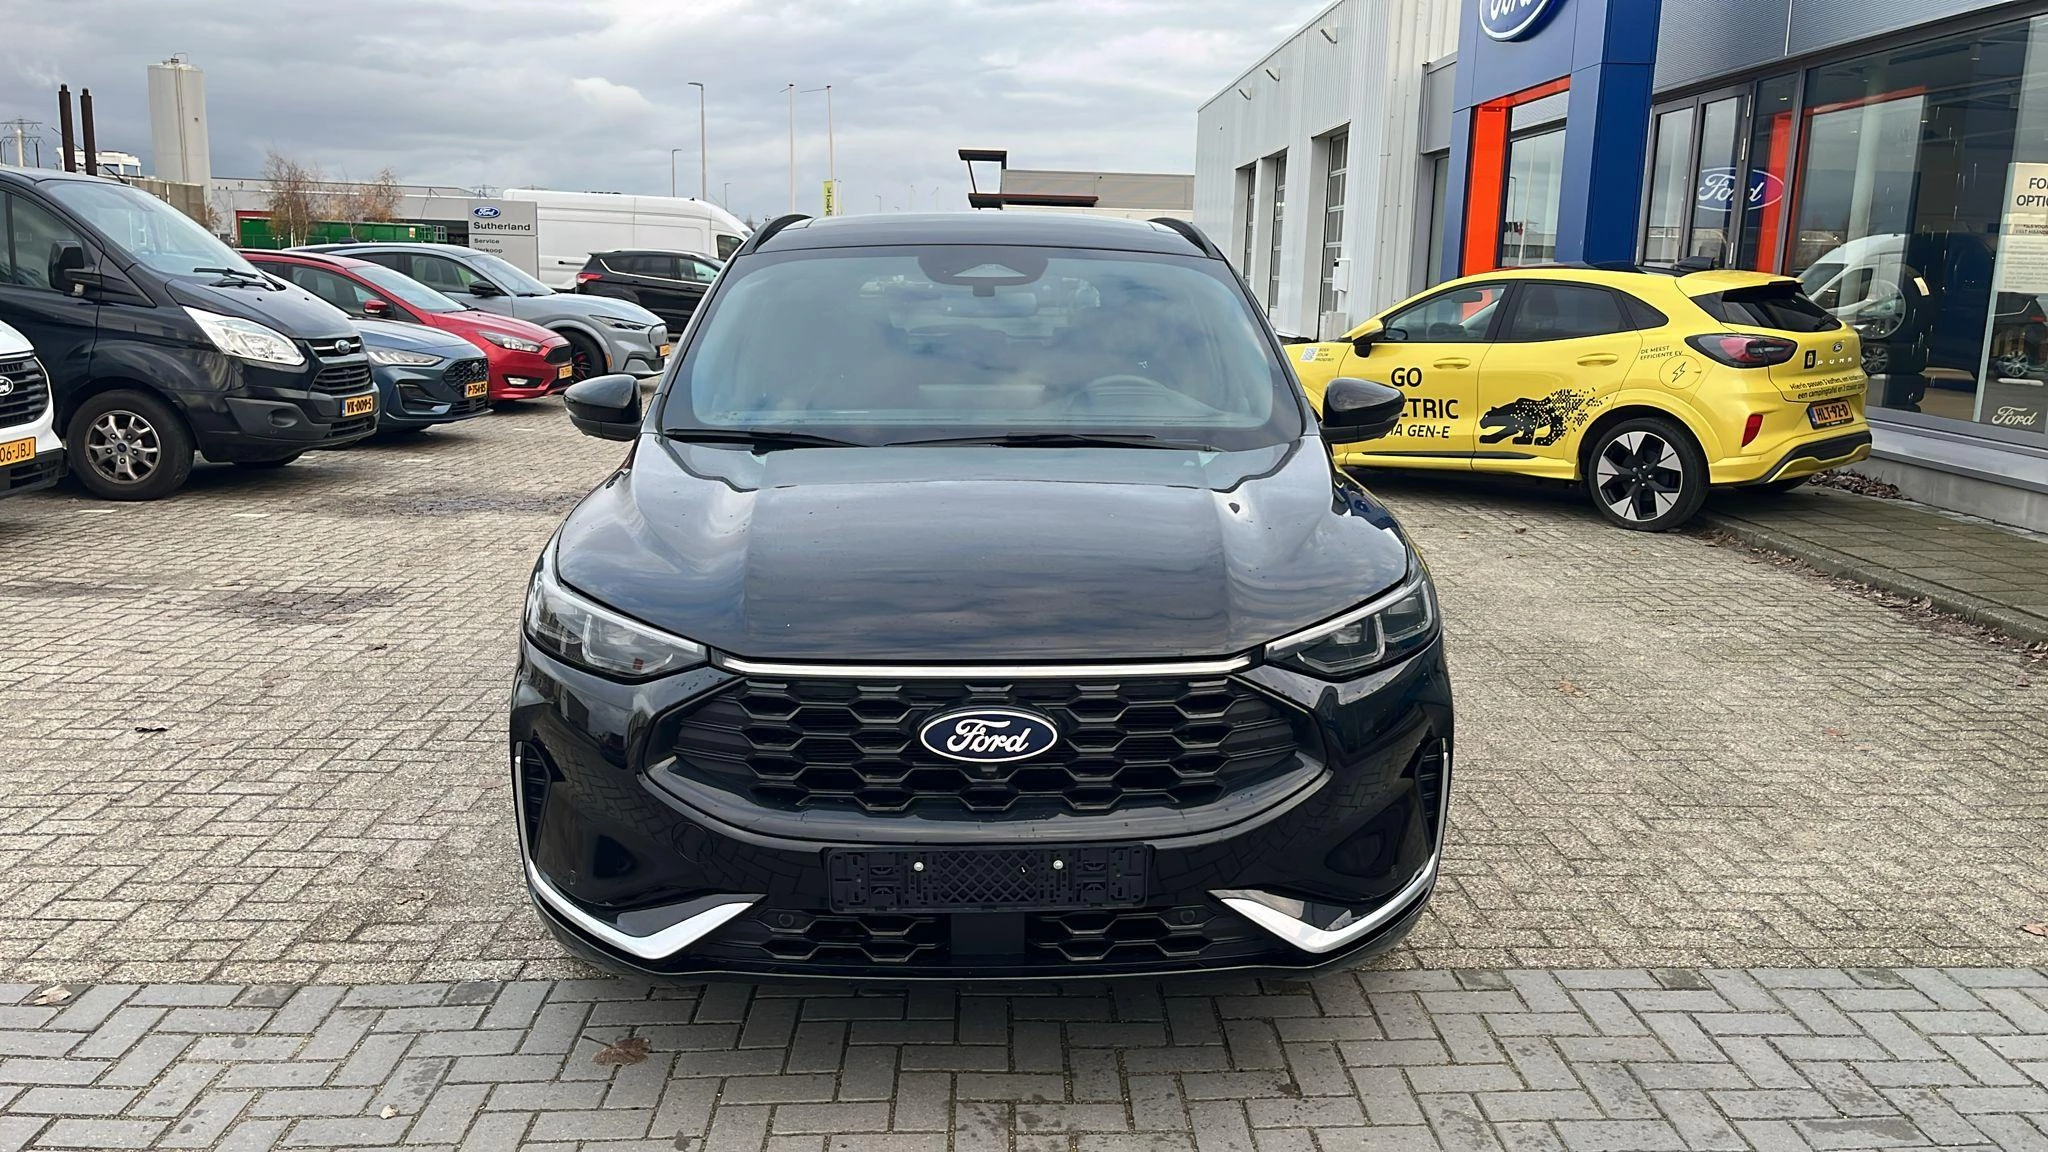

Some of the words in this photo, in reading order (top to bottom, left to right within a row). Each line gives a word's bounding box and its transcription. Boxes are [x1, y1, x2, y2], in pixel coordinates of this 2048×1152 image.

[1698, 173, 1765, 202] Fod
[2028, 177, 2048, 189] FO
[2016, 195, 2048, 207] OPTI
[473, 221, 531, 231] Sutherland
[1640, 351, 1673, 360] EFFICIENTE
[1391, 367, 1422, 387] GO
[1401, 398, 1459, 420] TRIC
[1815, 404, 1849, 421] HLT-92-D
[1991, 406, 2038, 426] Ford
[1407, 424, 1450, 438] GEN-E
[946, 718, 1032, 752] Ford
